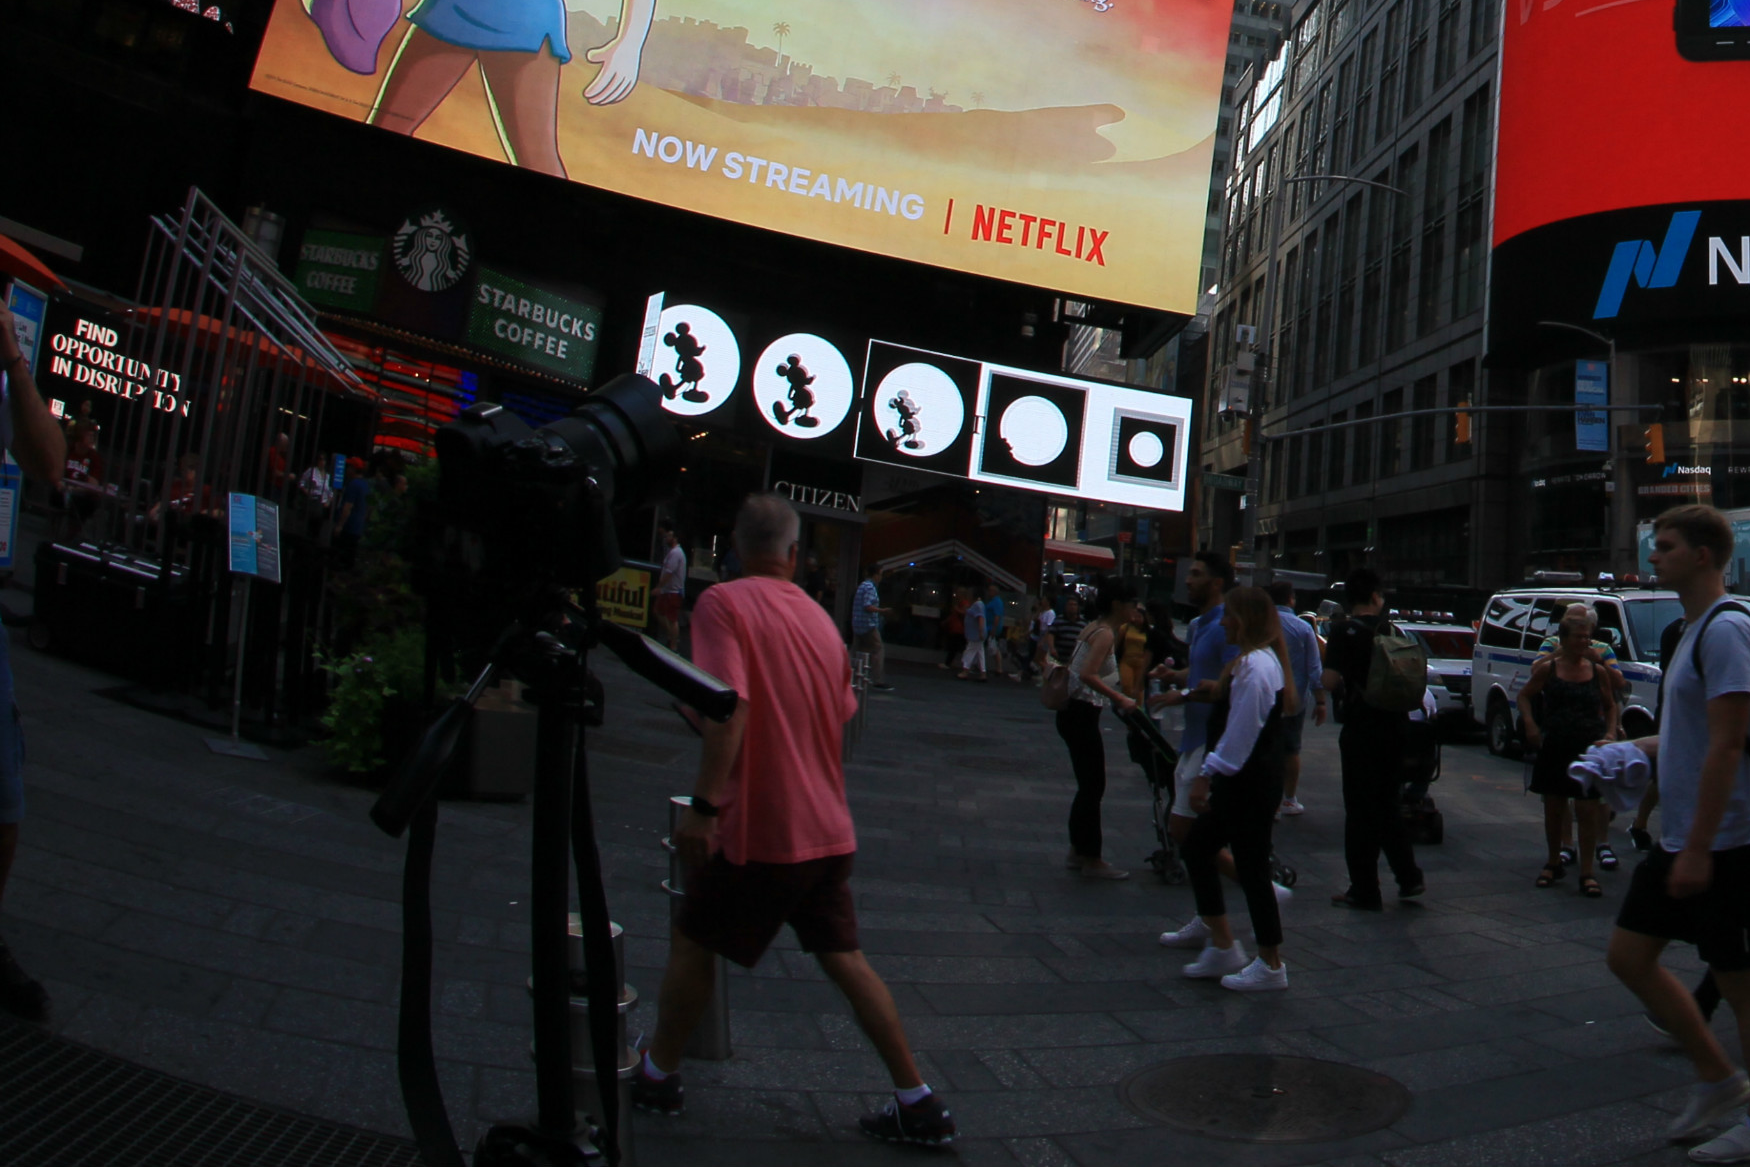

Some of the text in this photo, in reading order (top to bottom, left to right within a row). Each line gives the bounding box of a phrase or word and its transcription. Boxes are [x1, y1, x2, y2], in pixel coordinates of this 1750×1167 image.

[631, 127, 1109, 266] NOW STREAMING NETFLIX
[300, 243, 380, 271] STARBUCKS
[305, 270, 358, 295] COFFEE
[476, 283, 597, 342] STARBUCKS
[75, 317, 119, 348] FIND
[493, 317, 569, 360] COFFEE
[50, 355, 73, 378] IN
[51, 333, 182, 393] OPPORTUNTY
[1677, 465, 1712, 476] Nasdaq
[774, 480, 862, 513] CITIZEN
